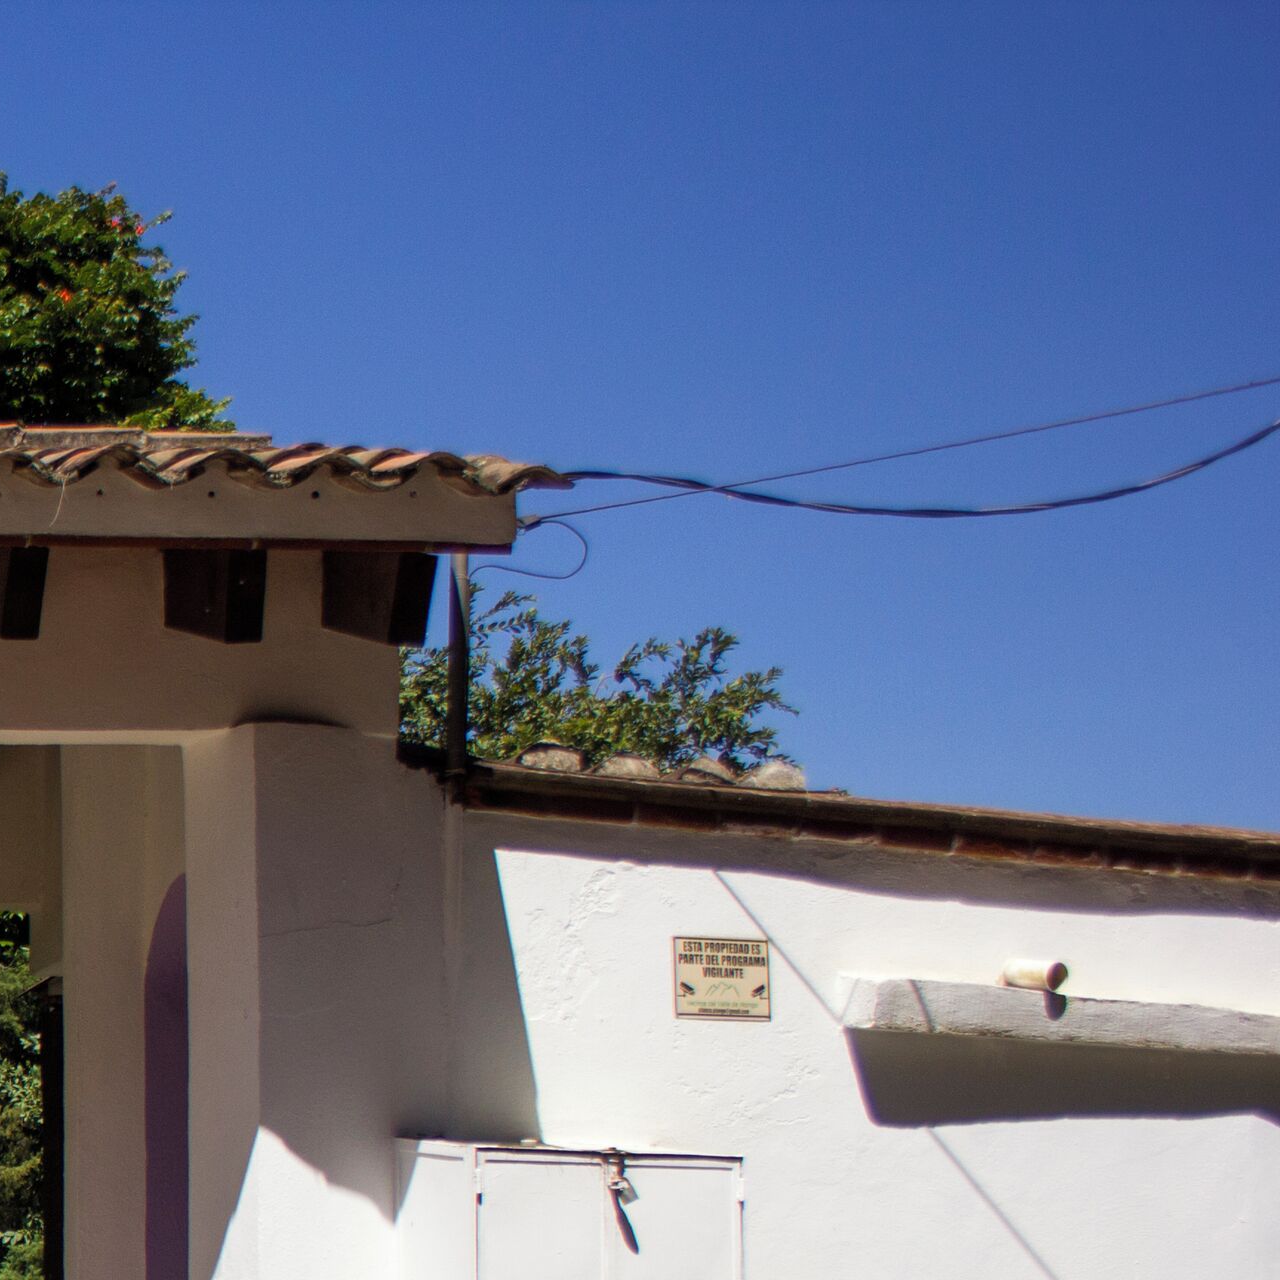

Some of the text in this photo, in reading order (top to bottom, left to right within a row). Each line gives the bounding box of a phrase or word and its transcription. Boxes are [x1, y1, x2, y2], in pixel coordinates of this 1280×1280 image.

[683, 941, 761, 955] ESTA PROPIEDAD ES
[678, 953, 766, 967] PARTE DEL PROGRAMA
[702, 967, 744, 979] VIGILANTE
